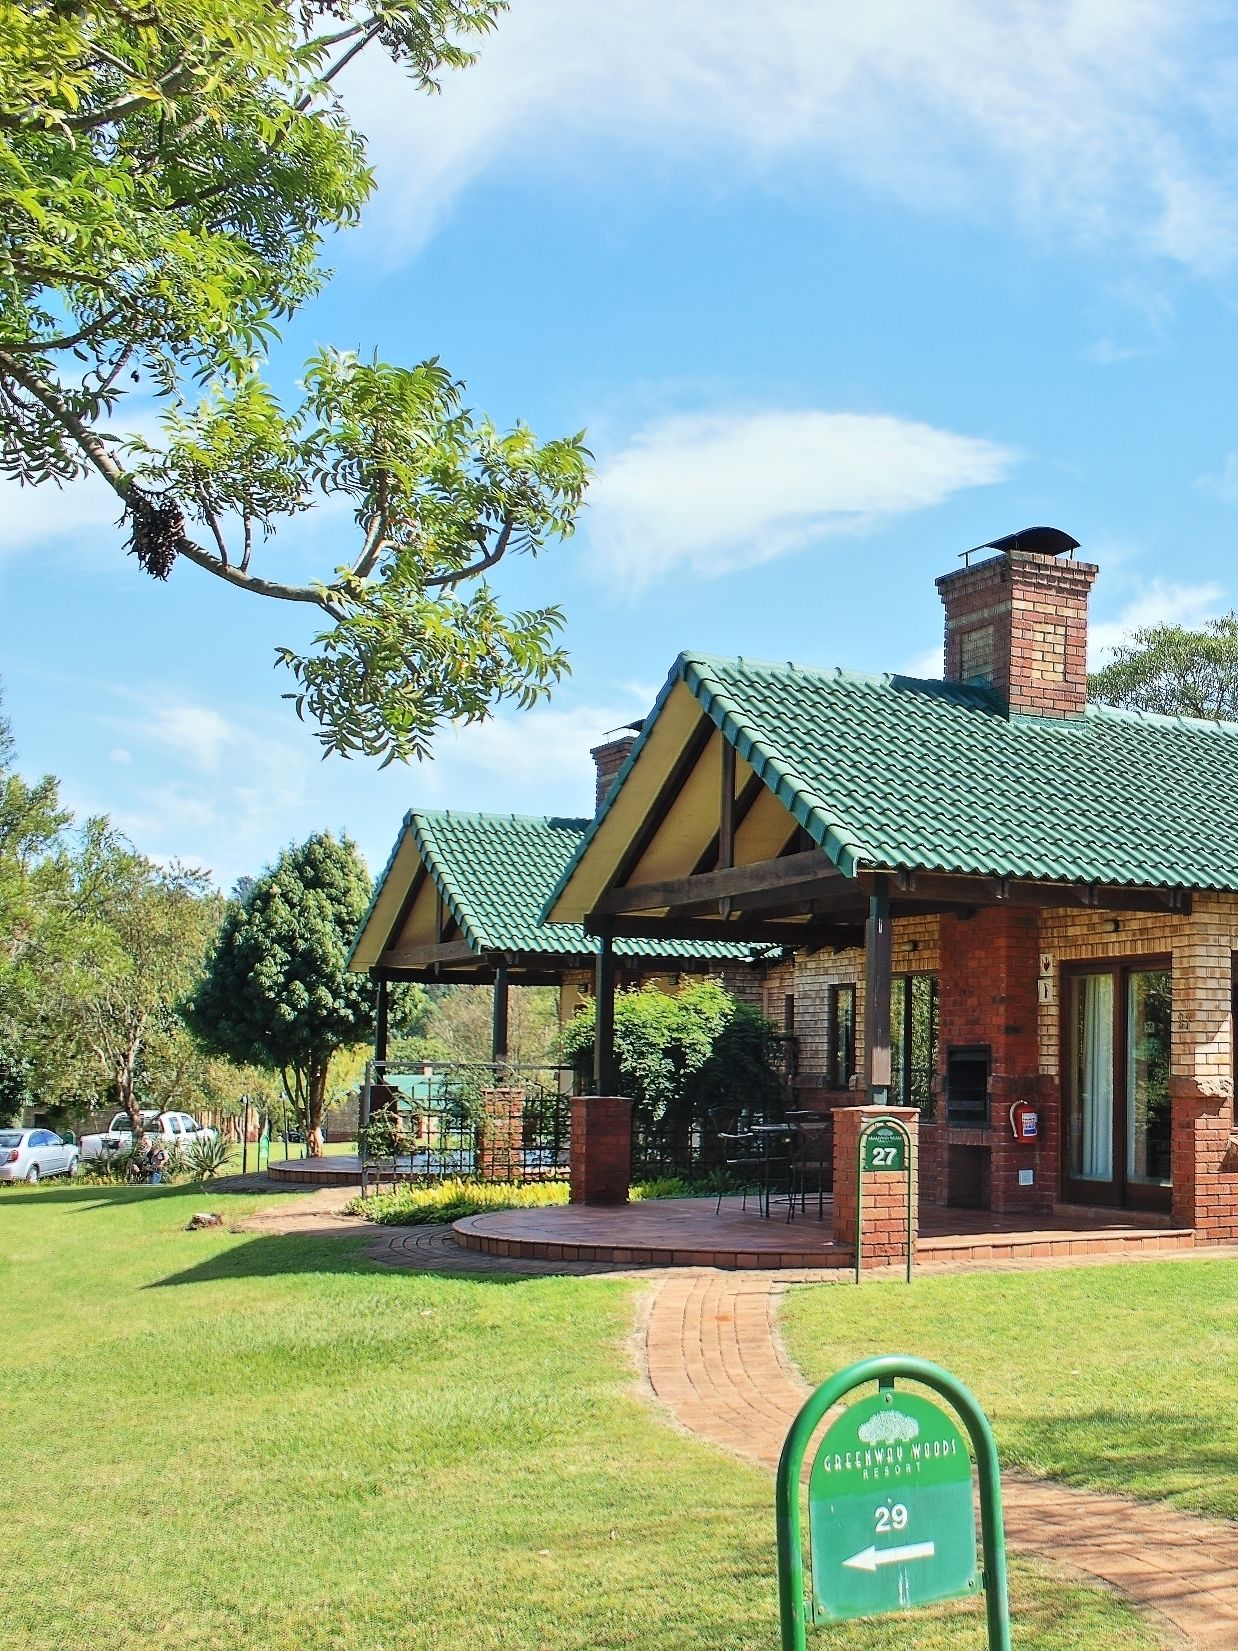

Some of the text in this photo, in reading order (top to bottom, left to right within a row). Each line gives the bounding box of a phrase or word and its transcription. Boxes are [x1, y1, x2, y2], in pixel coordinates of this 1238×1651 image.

[872, 1147, 898, 1166] 27
[824, 1438, 957, 1473] GREENWAY WOODS
[862, 1461, 921, 1480] RESORT
[874, 1503, 909, 1533] 29
